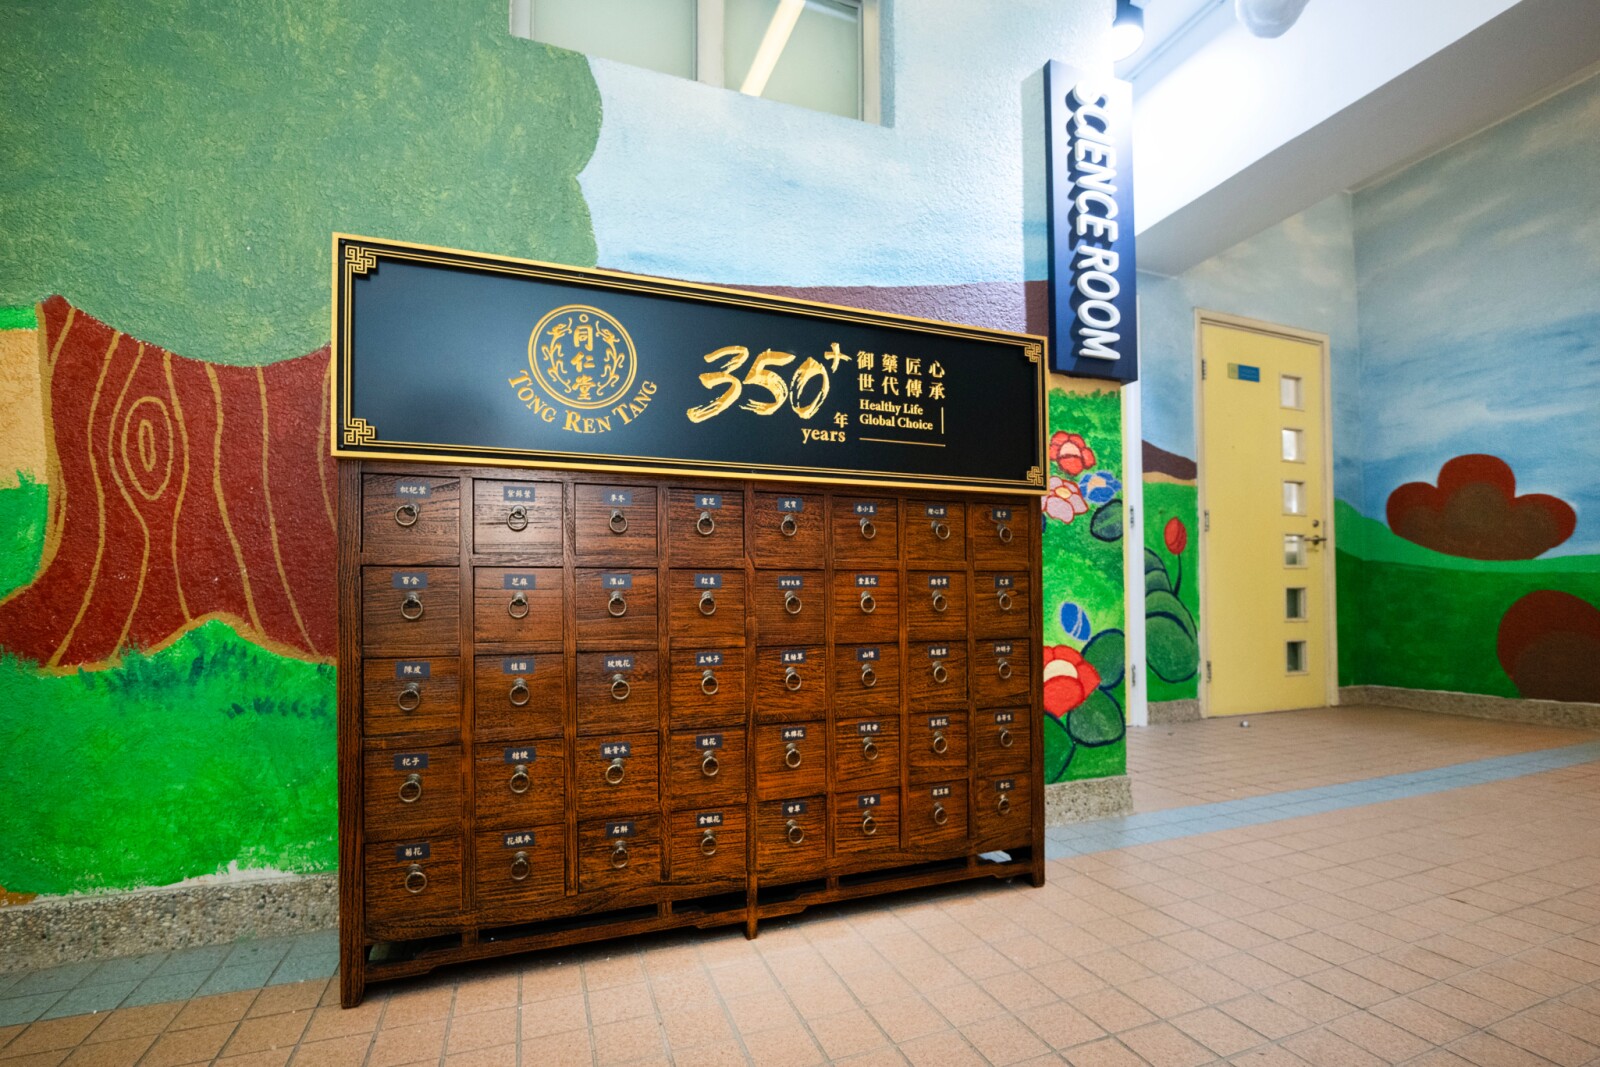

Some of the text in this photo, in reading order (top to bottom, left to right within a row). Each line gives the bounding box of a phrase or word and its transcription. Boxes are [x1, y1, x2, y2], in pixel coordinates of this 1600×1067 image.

[1072, 80, 1121, 360] SCIENCE ROOM
[570, 324, 596, 400] 同仁堂
[857, 350, 945, 378] 御藥匠心
[857, 373, 946, 400] 世代傳承
[508, 368, 657, 434] TONG REN TANG
[859, 399, 923, 416] Healthy Life
[833, 412, 849, 428] 年
[859, 414, 933, 430] Global Choice
[801, 427, 846, 444] years
[402, 576, 420, 585] 百合
[511, 577, 528, 586] 芝麻
[609, 577, 625, 585] 淮山
[701, 577, 716, 586] 紅棗
[699, 655, 720, 664] 五味子
[784, 652, 804, 661] 夏枯草
[510, 662, 527, 671] 桂圓
[607, 659, 631, 668] 玫瑰花
[403, 665, 422, 674] 陳皮
[784, 729, 804, 738] 木棉花
[702, 737, 717, 746] 桂花
[512, 751, 528, 760] 桔梗
[402, 757, 420, 766] 杞子
[863, 796, 875, 805] 丁香
[699, 815, 721, 824] 金銀花
[612, 825, 628, 834] 石斛
[405, 847, 423, 857] 菊花
